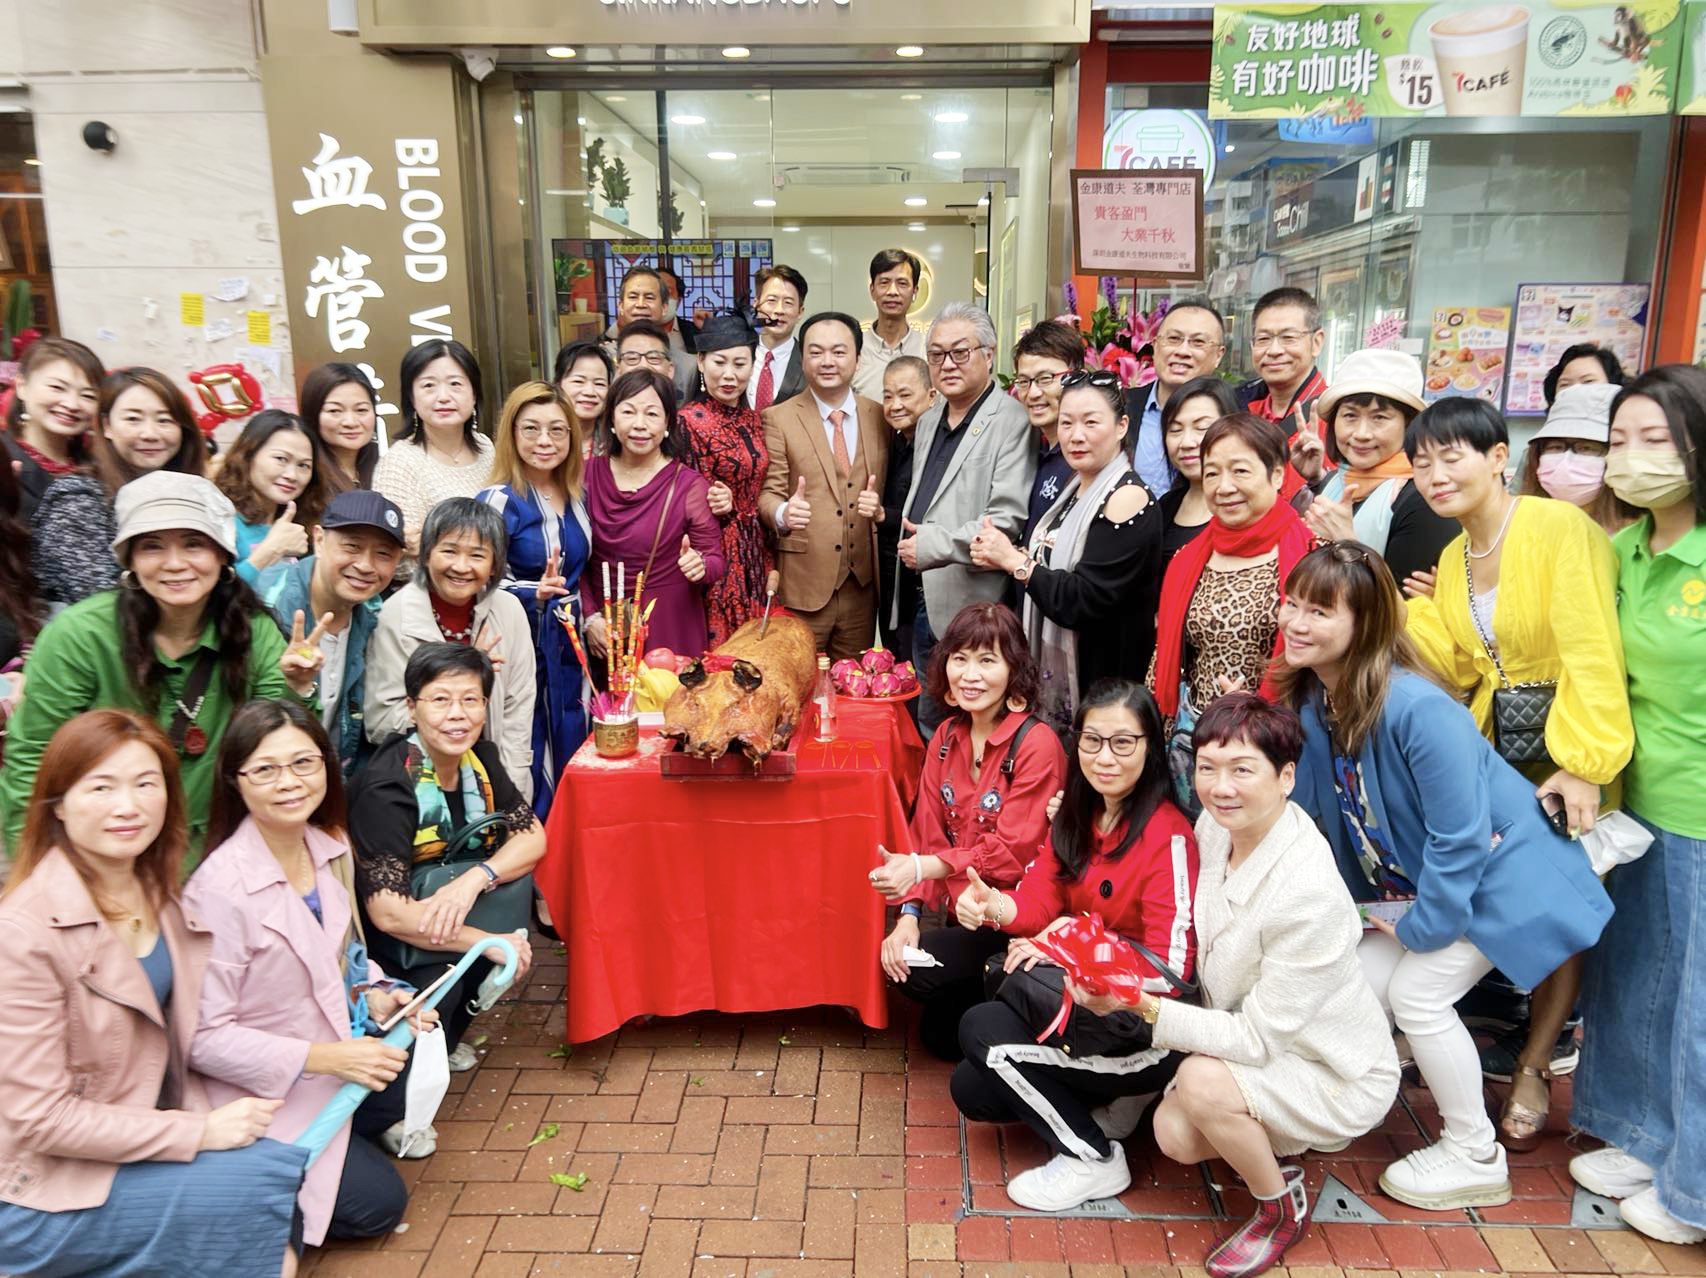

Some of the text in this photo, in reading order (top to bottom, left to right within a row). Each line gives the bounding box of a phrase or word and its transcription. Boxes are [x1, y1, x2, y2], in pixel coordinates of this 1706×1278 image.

[1247, 12, 1361, 52] 友好地球
[1232, 48, 1379, 96] 有好咖啡
[1080, 182, 1192, 196] 金康道夫 荃灣專門店
[395, 138, 448, 283] BLOOD
[1094, 205, 1148, 221] 貴客盈門
